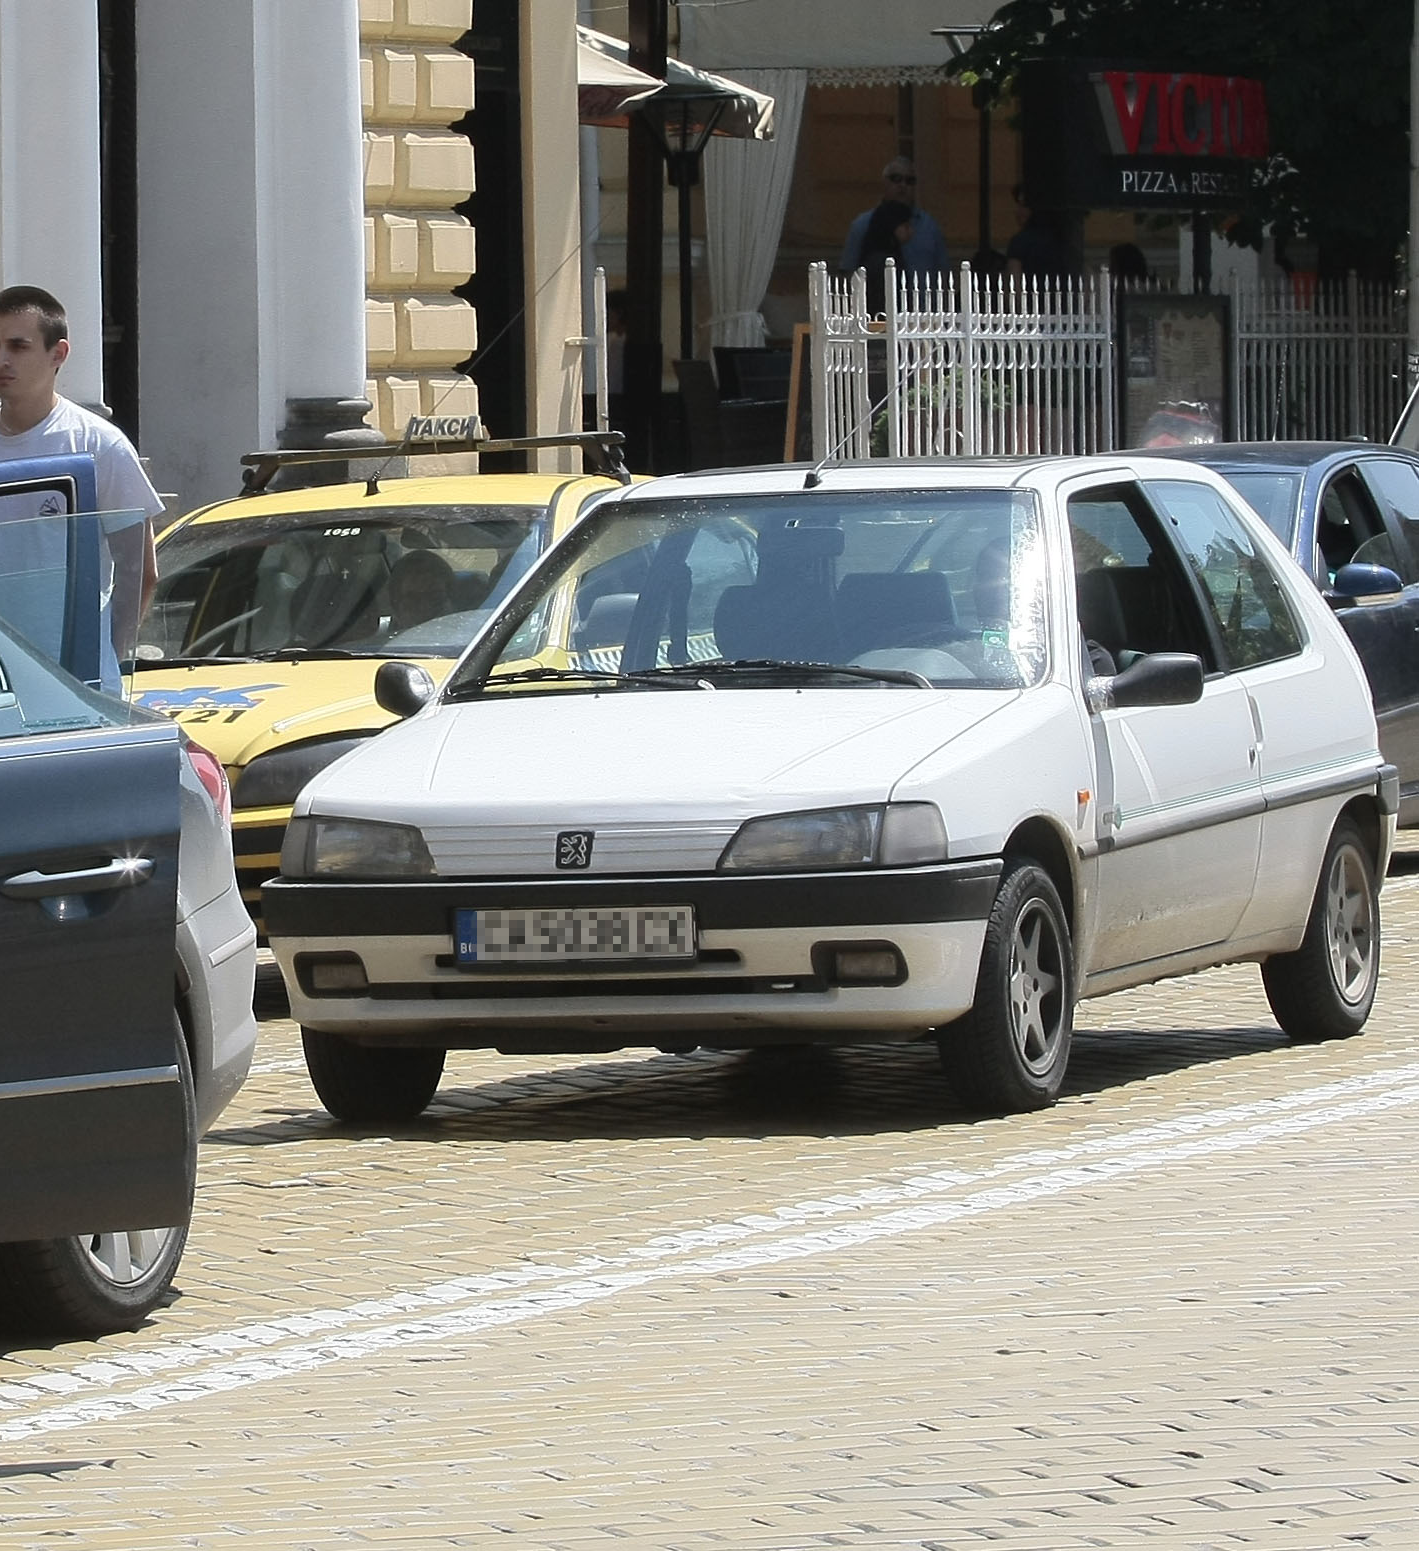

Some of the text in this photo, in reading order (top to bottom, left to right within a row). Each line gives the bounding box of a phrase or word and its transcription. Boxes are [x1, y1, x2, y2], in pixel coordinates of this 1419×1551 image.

[1120, 169, 1179, 194] PIZZA
[411, 417, 475, 437] ТАКСИ
[323, 527, 362, 538] 1058
